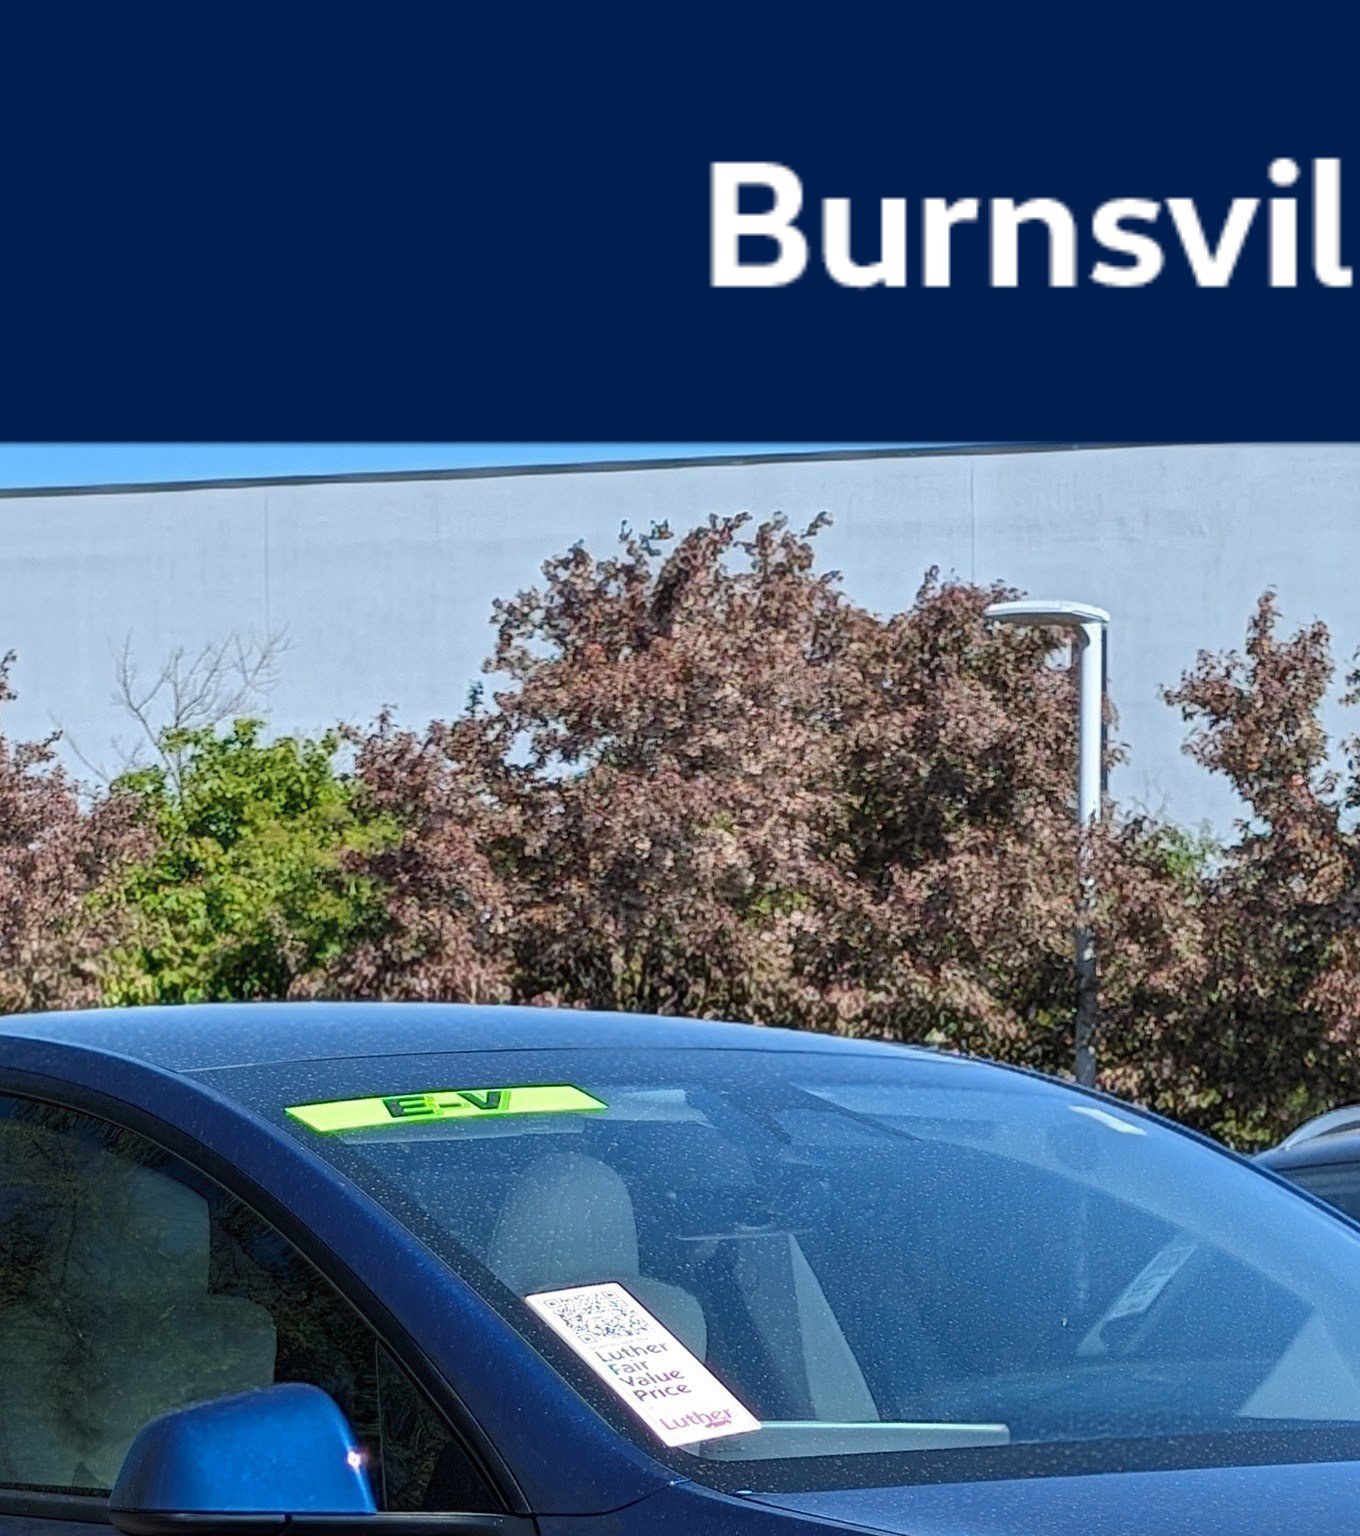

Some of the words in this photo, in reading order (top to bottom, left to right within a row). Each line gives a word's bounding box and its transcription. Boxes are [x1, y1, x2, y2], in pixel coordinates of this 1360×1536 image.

[381, 1089, 513, 1119] E-V
[594, 1341, 669, 1363] Luther
[607, 1360, 650, 1376] Fair
[619, 1369, 685, 1388] Value
[632, 1382, 692, 1402] Price
[659, 1408, 733, 1431] Luther
